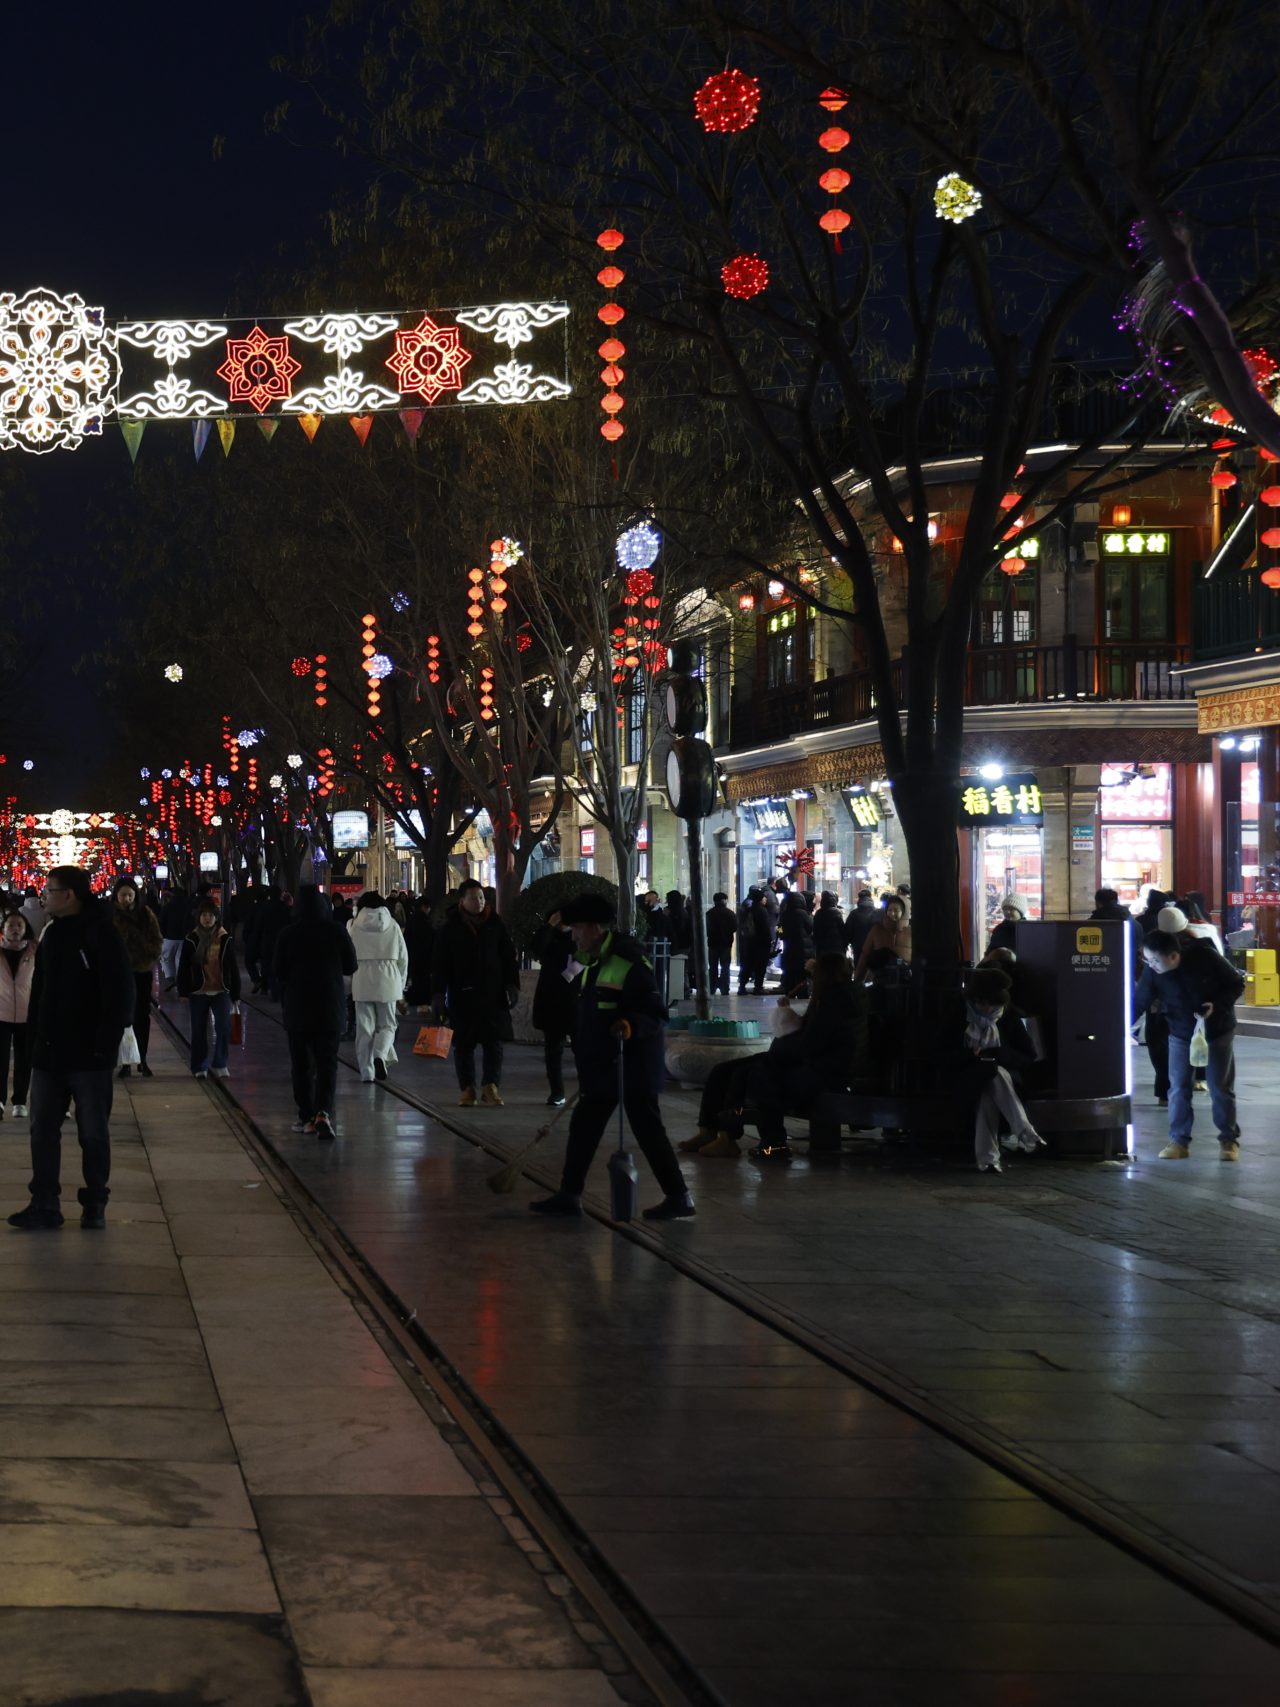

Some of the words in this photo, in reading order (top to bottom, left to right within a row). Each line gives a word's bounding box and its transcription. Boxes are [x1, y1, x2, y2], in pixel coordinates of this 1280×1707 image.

[1105, 533, 1166, 553] 稻香村
[962, 785, 1041, 815] 稻香村
